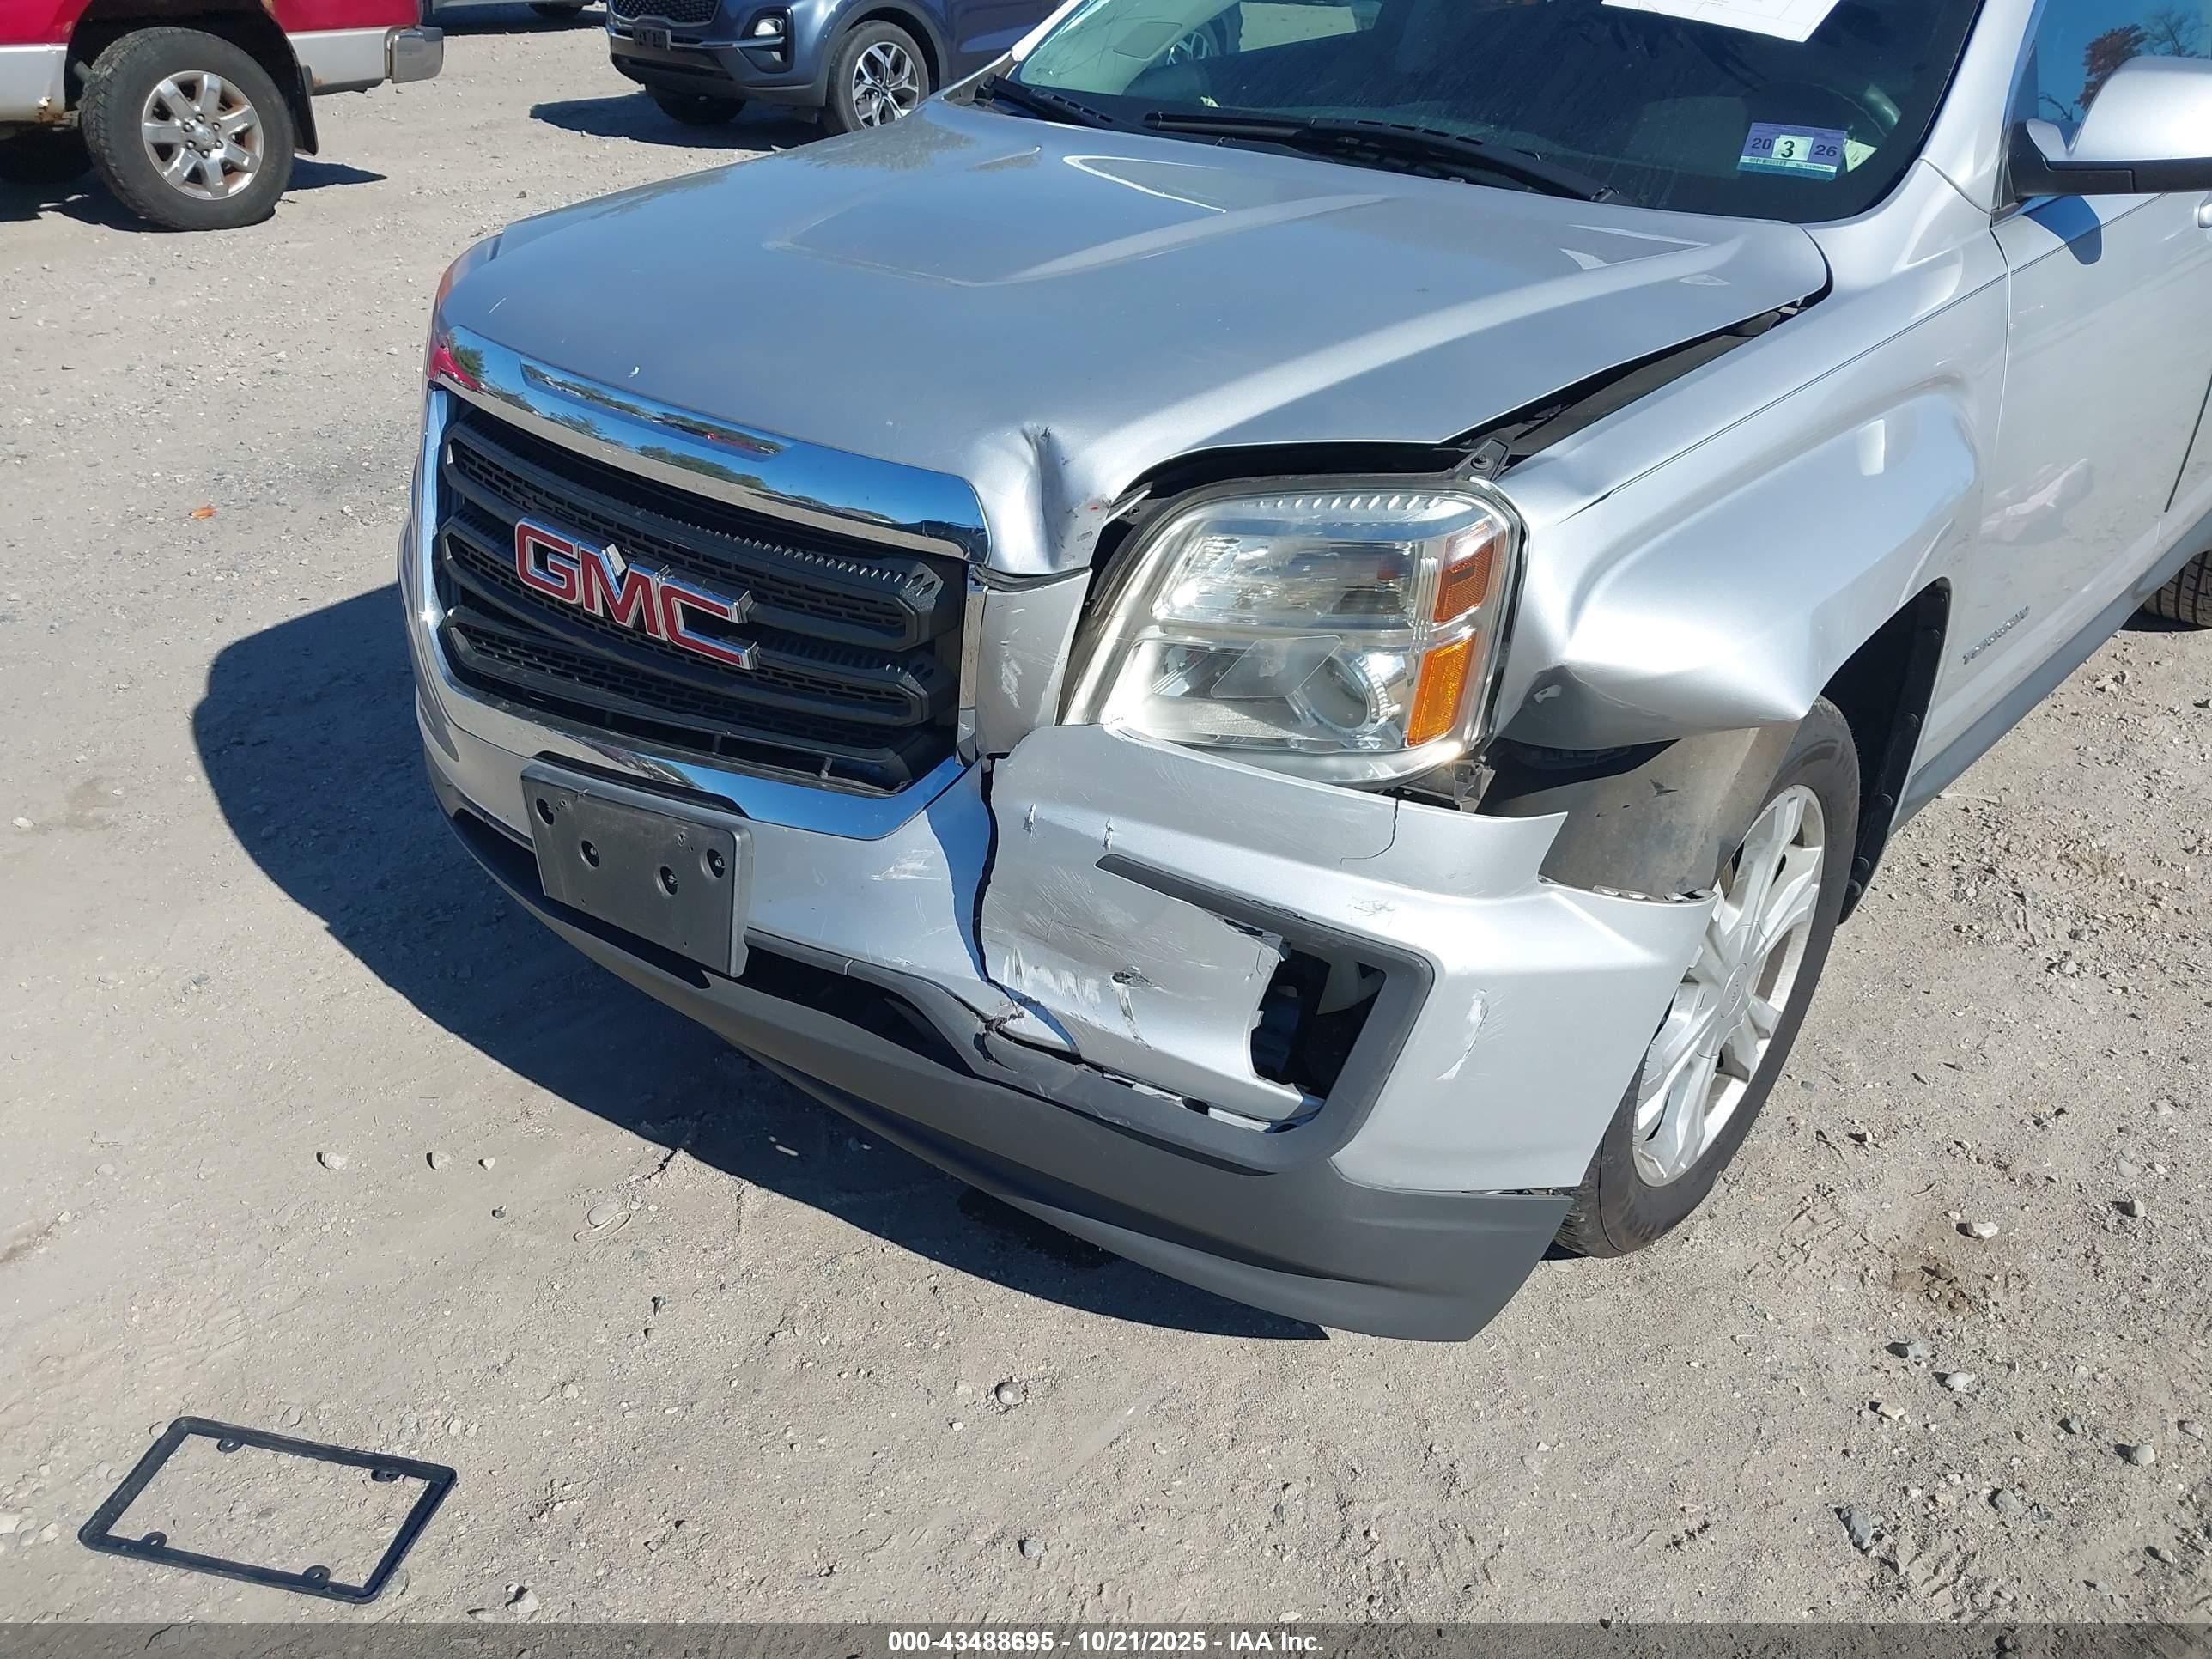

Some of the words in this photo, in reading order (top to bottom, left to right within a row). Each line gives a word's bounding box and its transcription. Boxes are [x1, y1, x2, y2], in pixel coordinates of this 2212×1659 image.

[1752, 138, 1771, 149] 20
[1781, 141, 1795, 158] 3
[1814, 145, 1837, 157] 26
[516, 517, 755, 670] GMC
